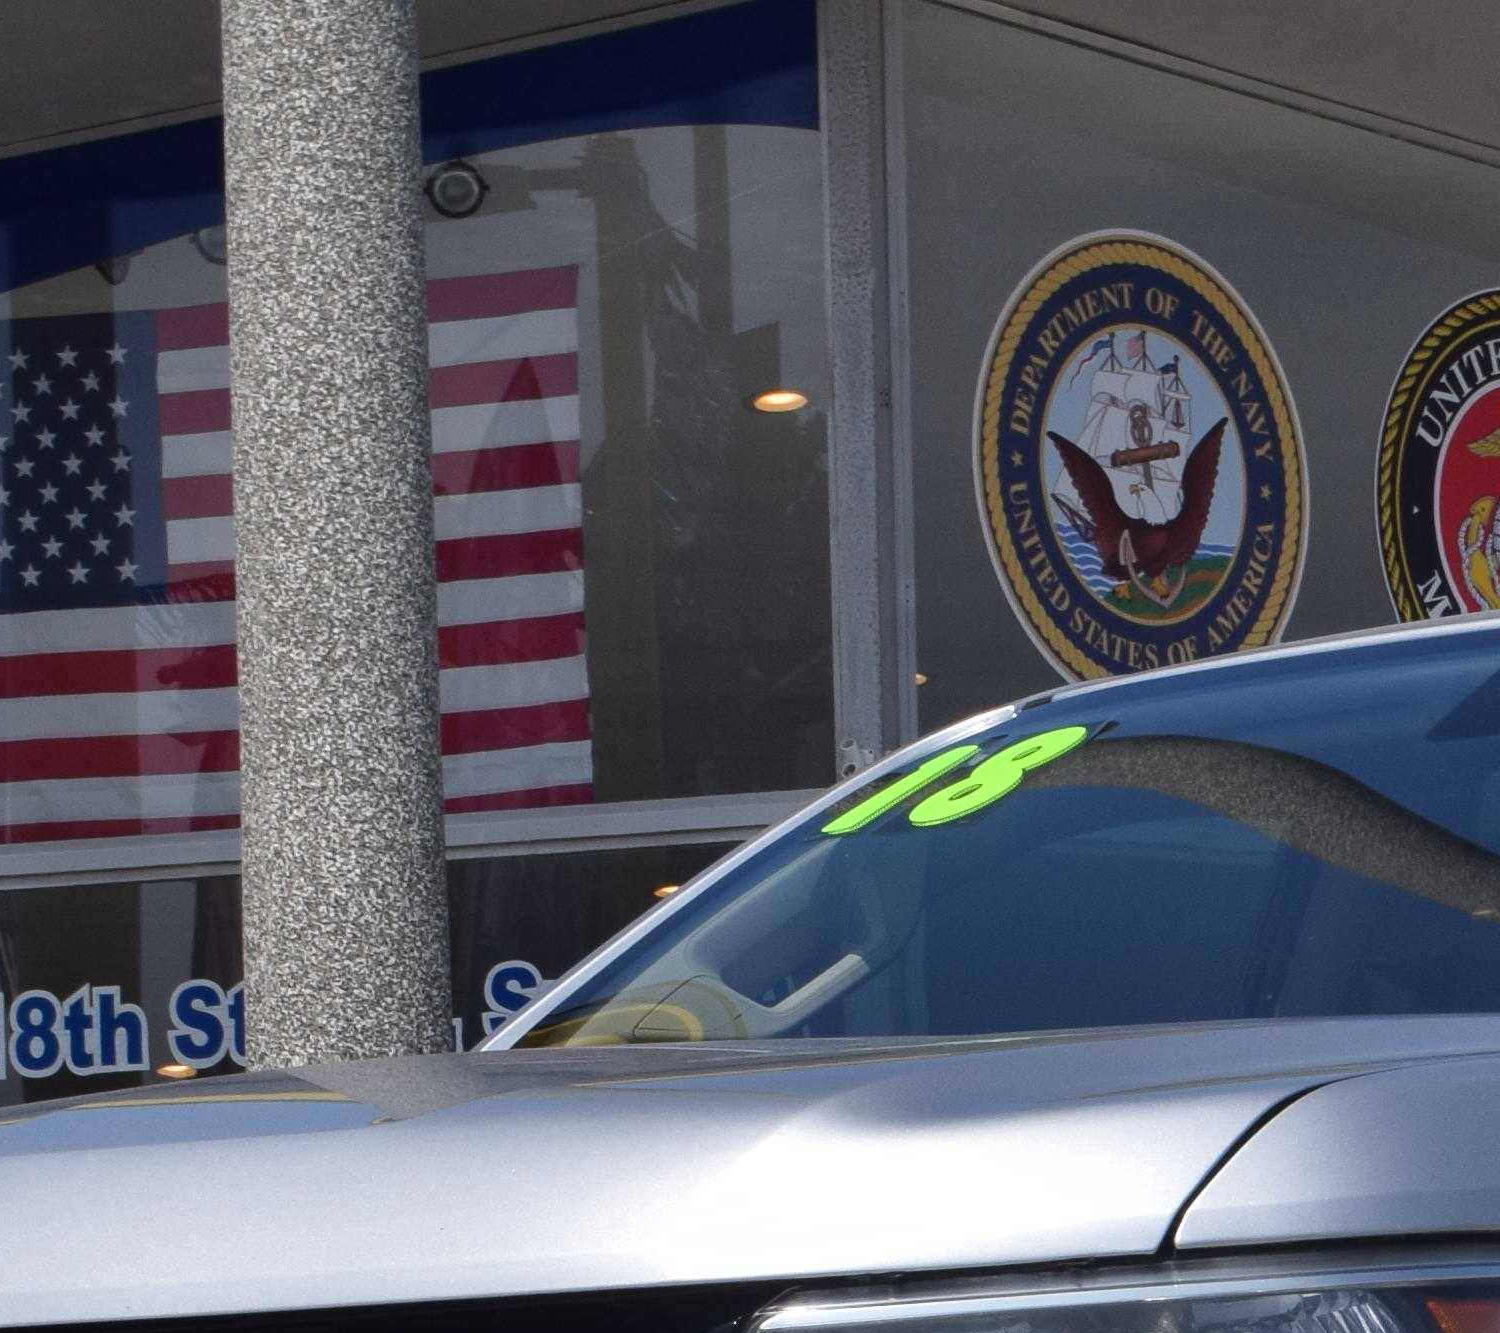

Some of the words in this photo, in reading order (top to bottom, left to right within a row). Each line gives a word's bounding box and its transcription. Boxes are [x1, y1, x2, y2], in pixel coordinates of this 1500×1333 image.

[1009, 282, 1133, 437] DEPARTMENT
[1145, 285, 1180, 318] OF
[1189, 308, 1237, 372] THE
[1229, 365, 1279, 463] NAVY
[1005, 478, 1073, 616] UNITED
[1067, 605, 1161, 673] STATES
[1164, 628, 1204, 666] OF
[1203, 520, 1279, 656] AMERICA
